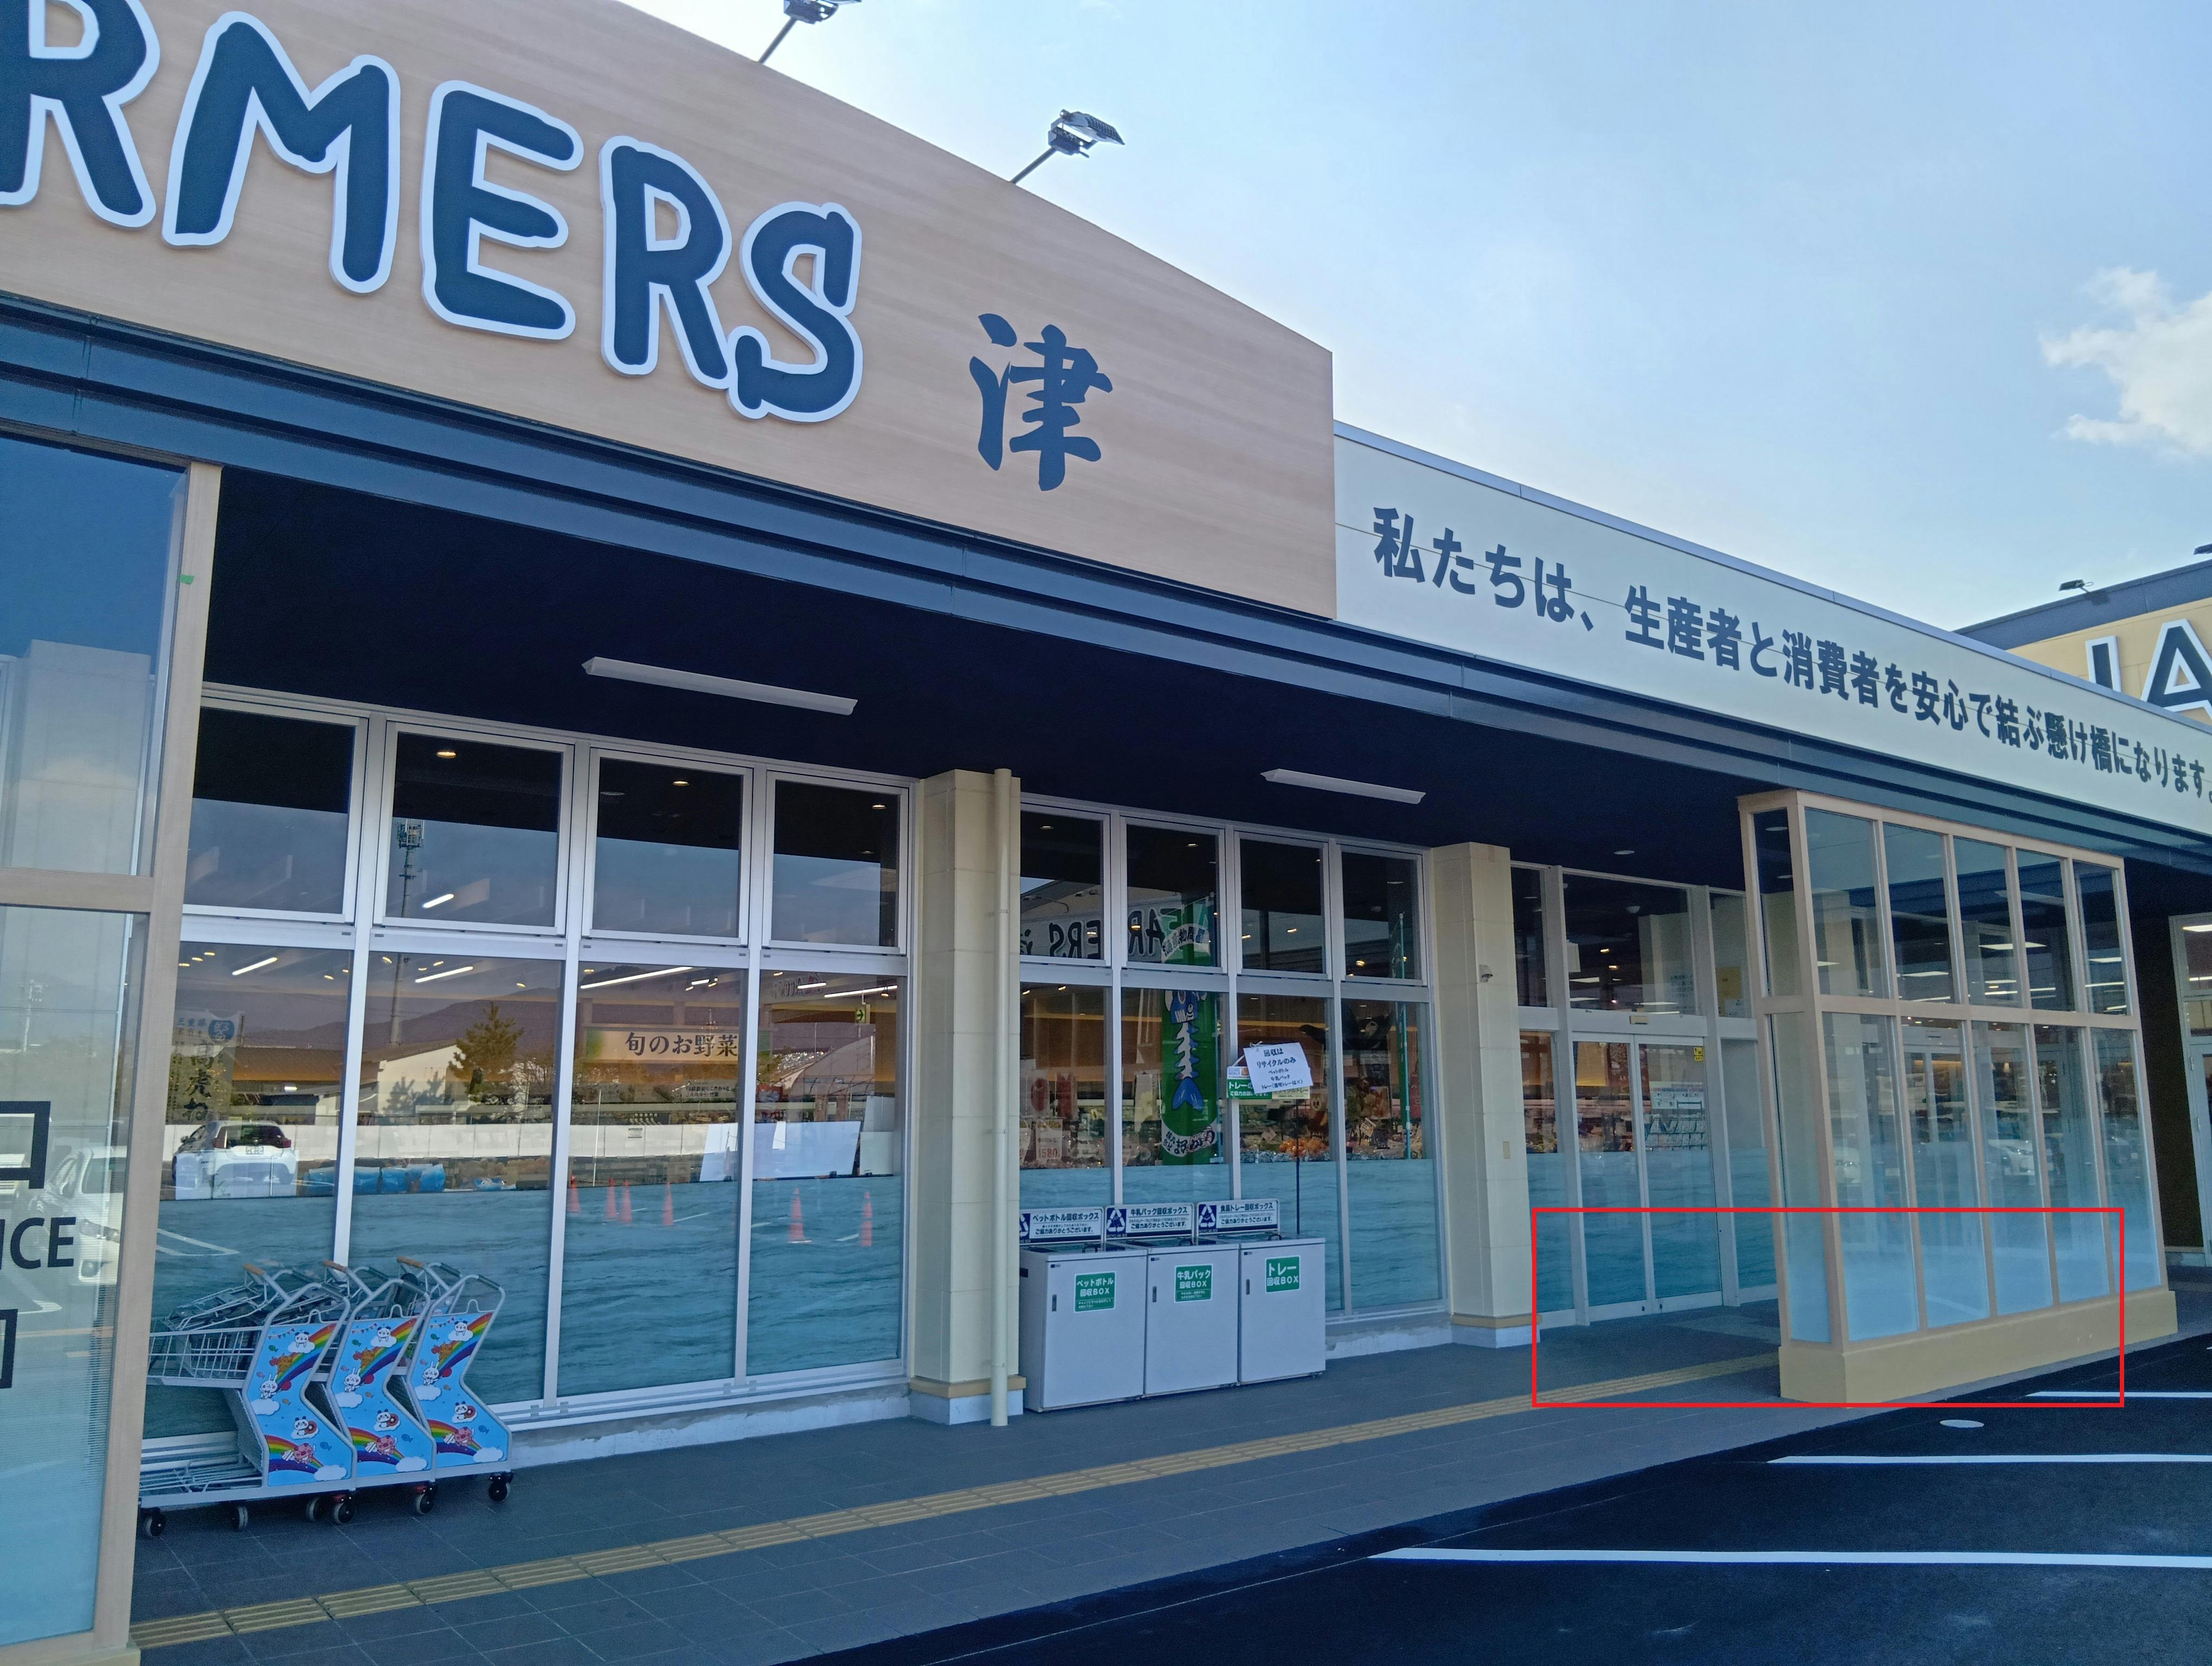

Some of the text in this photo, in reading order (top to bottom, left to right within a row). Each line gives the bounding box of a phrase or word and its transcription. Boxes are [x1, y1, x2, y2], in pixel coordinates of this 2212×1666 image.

[969, 313, 1113, 491] 津
[625, 1032, 738, 1056] 旬のお野菜
[1263, 1048, 1284, 1057] 回収は
[1256, 1057, 1296, 1068] リサイクルのみ
[1130, 1207, 1187, 1216] 牛乳パック回収ボックス
[1220, 1202, 1273, 1212] 食品トレー回収ボックス
[1032, 1213, 1099, 1222] ペットボトル回収ボックス
[0, 1216, 76, 1269] CE
[1177, 1270, 1211, 1280] 牛乳パック
[1269, 1263, 1297, 1277] トレー
[1077, 1277, 1114, 1287] ペットボトル
[1180, 1280, 1207, 1289] 回収BOX
[1267, 1275, 1299, 1286] 回収BOX
[1080, 1287, 1110, 1297] 回収BOX
